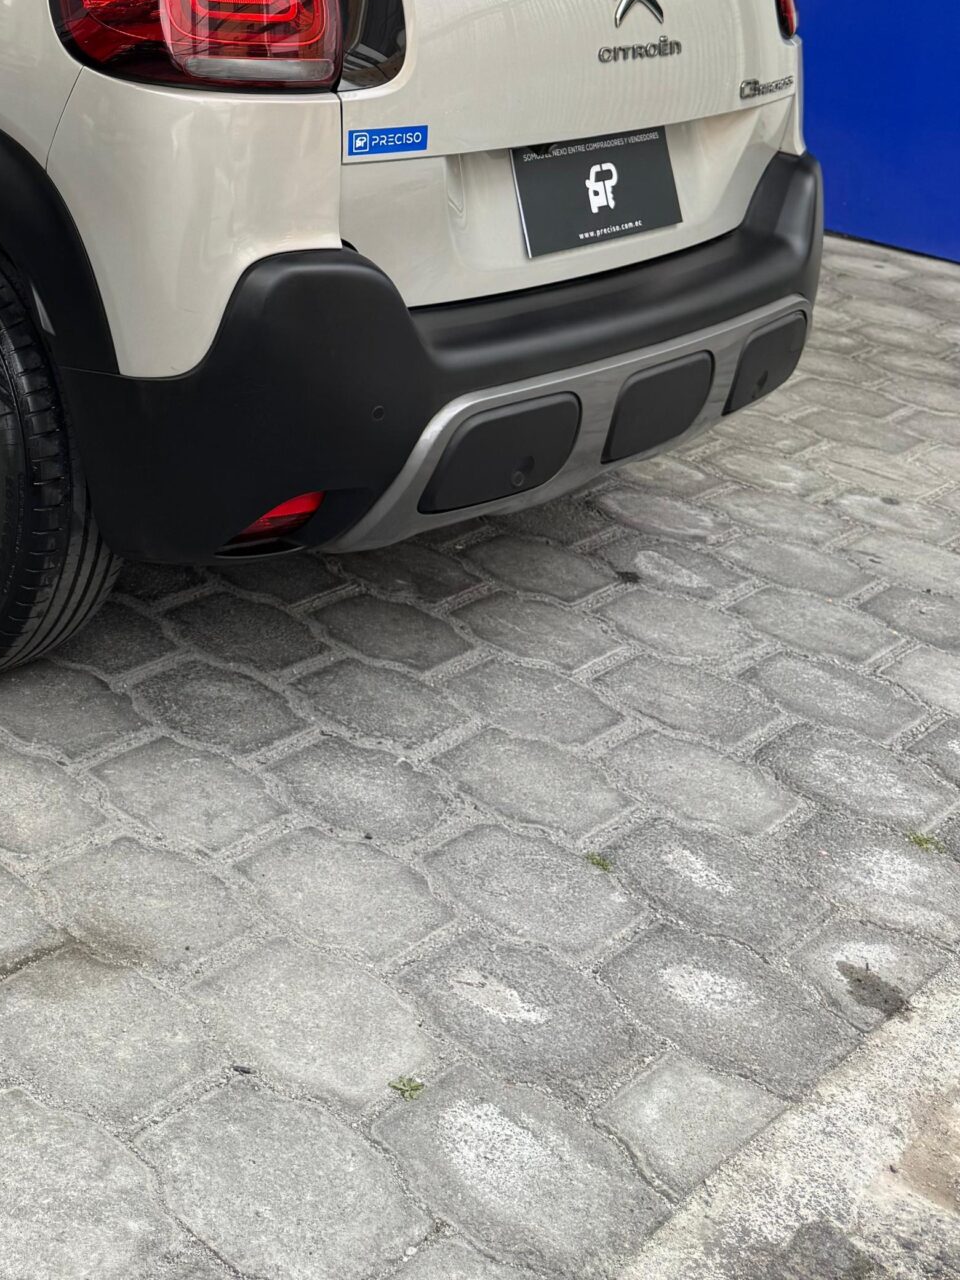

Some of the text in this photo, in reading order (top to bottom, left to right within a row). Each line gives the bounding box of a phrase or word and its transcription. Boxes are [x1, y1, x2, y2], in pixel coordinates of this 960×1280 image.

[371, 131, 423, 147] PRECISO
[568, 143, 586, 155] ENTRE
[586, 138, 624, 151] COMPRADORES
[628, 131, 659, 142] VENDEDORES
[578, 220, 642, 239] www.preciso.com.ec
